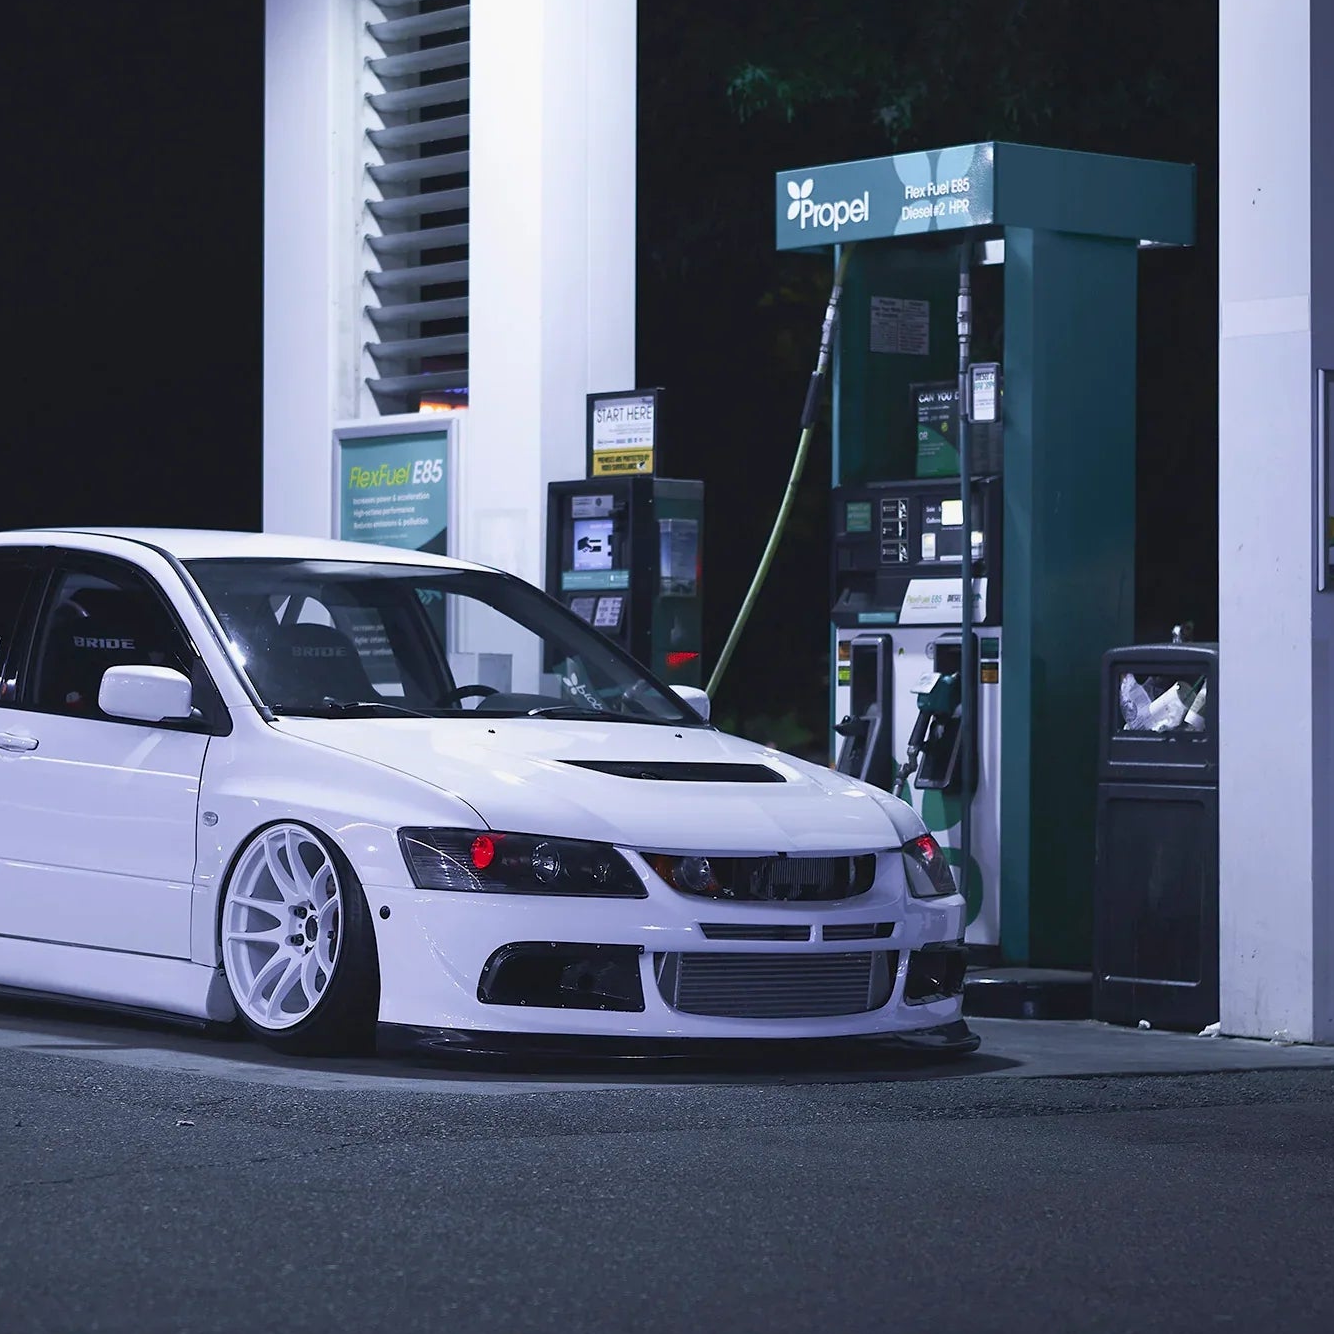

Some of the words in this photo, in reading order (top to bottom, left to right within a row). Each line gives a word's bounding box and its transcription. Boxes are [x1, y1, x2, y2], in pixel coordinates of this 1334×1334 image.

[904, 184, 925, 200] Flex
[927, 180, 949, 196] Fuel
[950, 177, 970, 194] E85
[800, 191, 869, 232] Propel
[901, 202, 933, 221] Diesel
[949, 198, 970, 215] HPR
[918, 393, 934, 403] CAN
[937, 391, 952, 401] YOU
[597, 407, 624, 424] START
[627, 405, 652, 421] HERE
[349, 462, 412, 488] FlexFuel
[412, 458, 444, 484] E85
[73, 635, 135, 649] BRIDE
[291, 646, 347, 657] BRIDE
